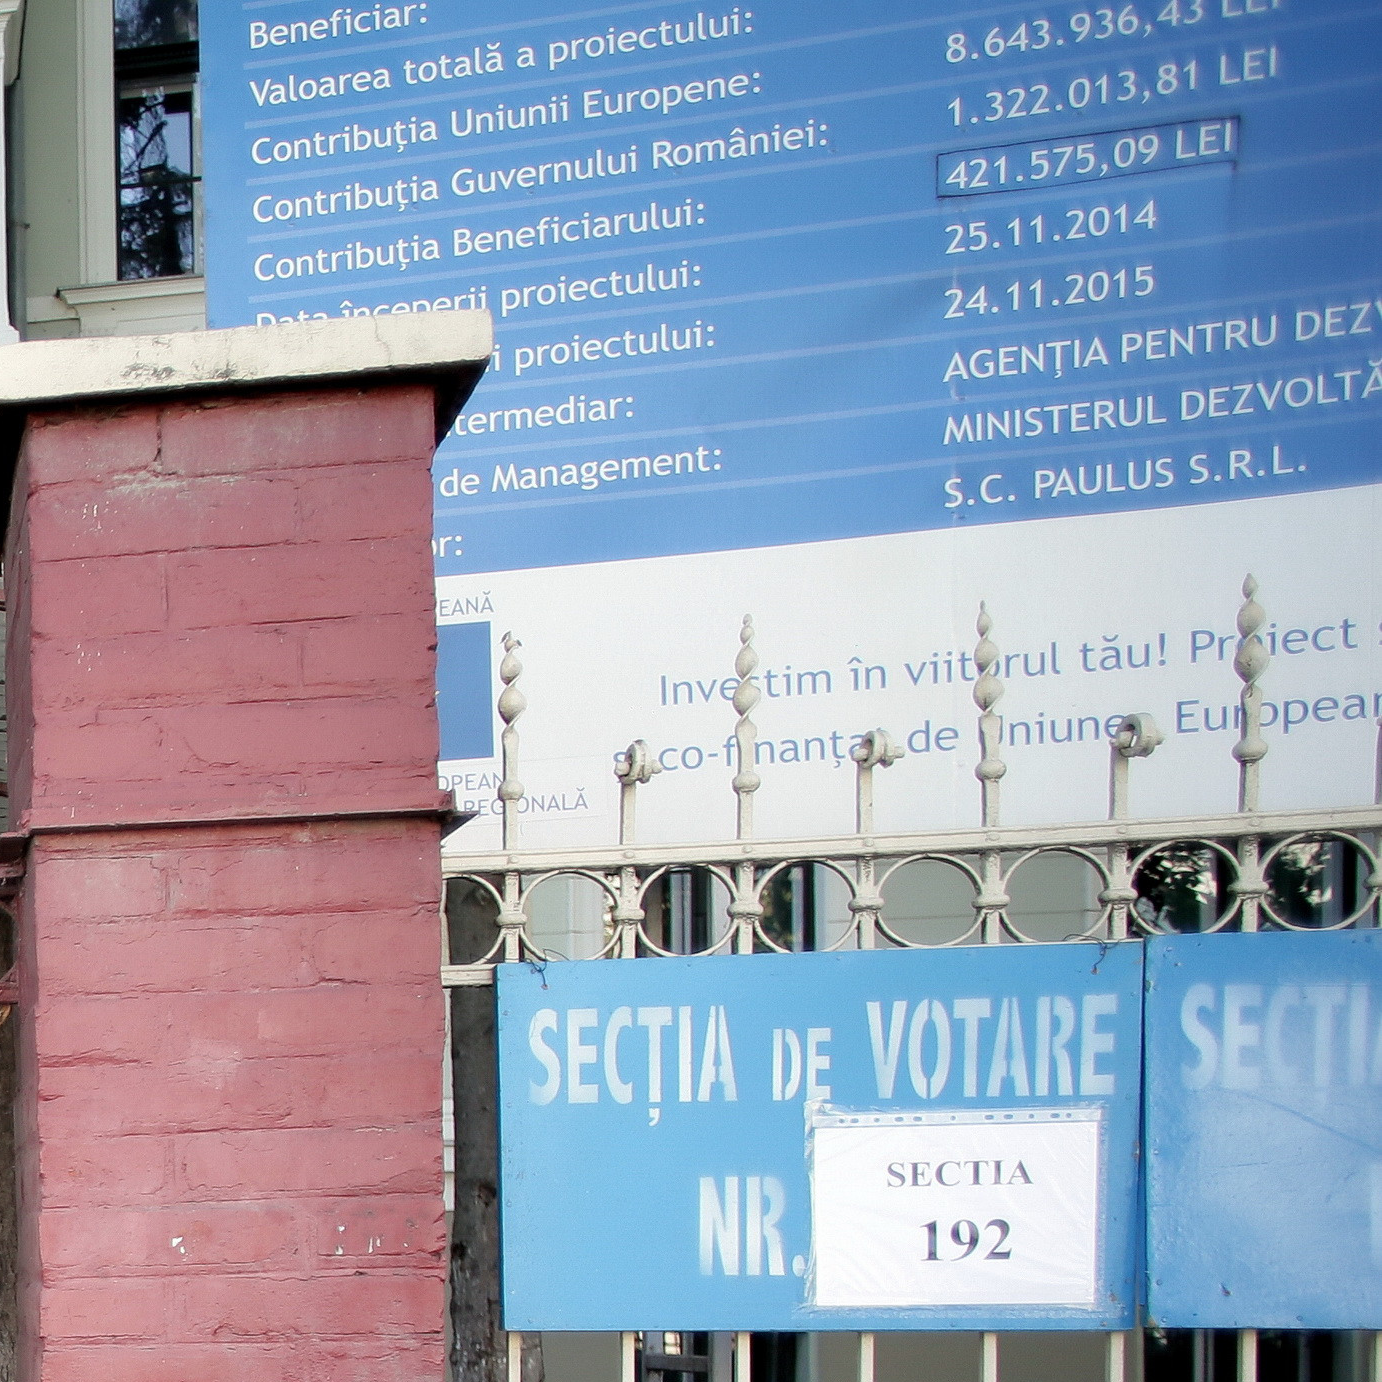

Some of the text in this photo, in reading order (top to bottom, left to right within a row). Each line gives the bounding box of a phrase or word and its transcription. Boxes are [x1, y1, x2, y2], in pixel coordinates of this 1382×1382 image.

[249, 2, 428, 50] Beneficiar:
[945, 0, 1204, 64] 8.643.936,43
[249, 8, 753, 107] Valoarea totală a proiectului:
[946, 46, 1278, 127] 1.322.013,81 LEI
[250, 72, 762, 165] Contribuția Uniunii Europene:
[252, 119, 829, 223] Contribuția Guvernului României:
[945, 121, 1233, 190] 421.575,09 LEI
[253, 201, 706, 282] Contribuția Beneficiarului:
[944, 199, 1158, 256] 25.11.2014
[501, 259, 703, 318] proiectului:
[943, 265, 1155, 320] 24.11.2015
[514, 320, 716, 376] proiectului:
[943, 336, 1109, 383] AGENȚIA
[1120, 314, 1278, 363] PENTRU
[447, 395, 635, 438] termediar:
[943, 395, 1168, 446] MINISTERUL
[439, 446, 723, 498] de Management:
[943, 444, 1308, 509] S.C. PAULUS S.R.L.
[847, 656, 887, 692] în
[1078, 632, 1168, 674] tău!
[906, 720, 959, 754] de
[464, 787, 589, 817] REGONALĂ
[527, 993, 1119, 1127] SECȚIA DE VOTARE
[886, 1159, 1034, 1188] SECTIA
[698, 1175, 808, 1278] NR.
[919, 1217, 1013, 1263] 192
